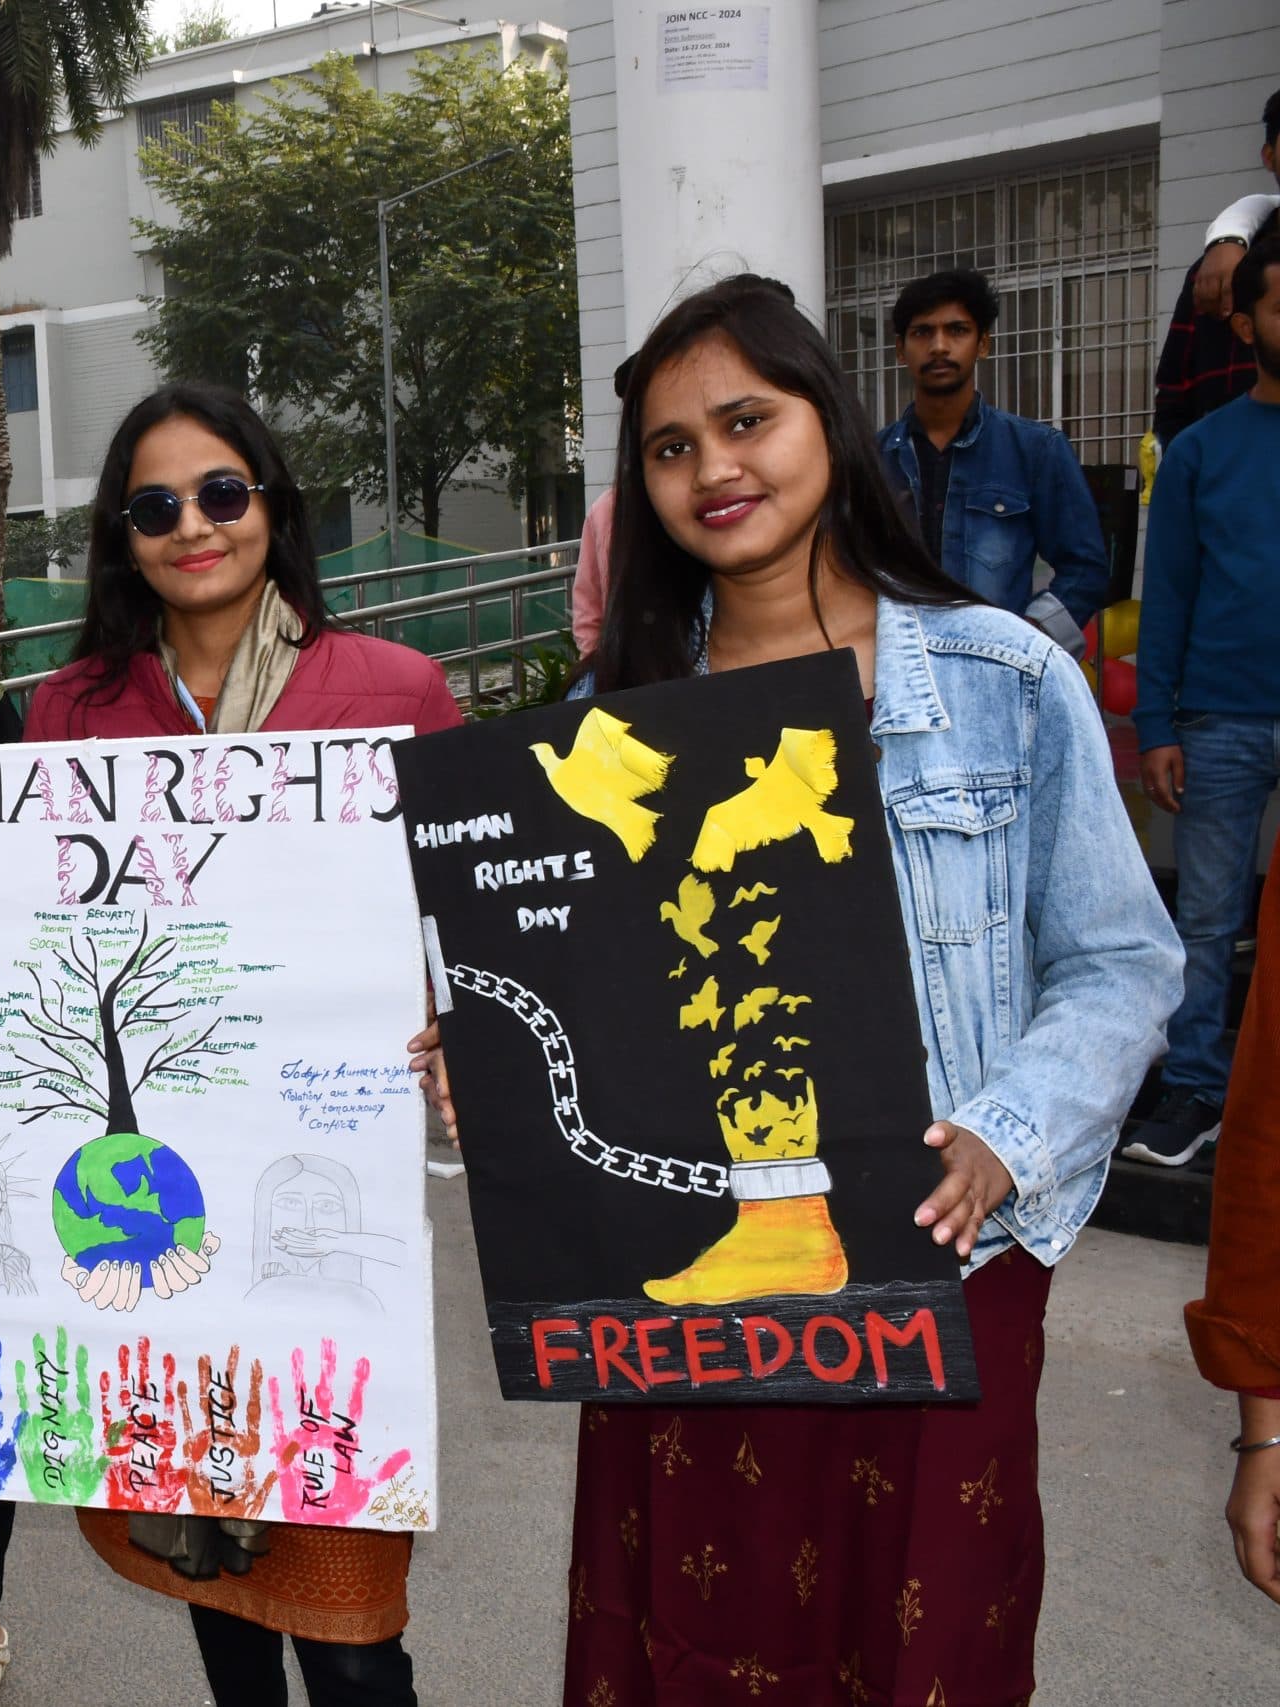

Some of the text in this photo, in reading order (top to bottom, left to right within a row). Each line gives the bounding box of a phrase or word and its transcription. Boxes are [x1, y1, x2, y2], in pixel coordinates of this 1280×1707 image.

[665, 13, 686, 24] JOIN
[688, 11, 708, 21] NCC
[719, 9, 741, 19] 2024
[140, 736, 404, 825] RIGHTS
[413, 811, 515, 849] HUMAN
[55, 832, 228, 907] DAY
[473, 849, 596, 892] RIGHTS
[85, 908, 136, 925] SECURITY
[516, 904, 572, 933] DAY
[166, 920, 233, 931] INTERNATIONAL
[29, 937, 67, 950] SOCIAL
[13, 959, 42, 969] ACTION
[176, 957, 219, 970] HARMONY
[8, 991, 35, 1001] MORAL
[61, 982, 88, 994] EQUAL
[120, 983, 144, 999] HOPE
[177, 996, 224, 1009] RESPECT
[0, 1007, 25, 1018] LEGAL
[66, 1005, 95, 1017] PEOPLE
[132, 1008, 160, 1018] PEACE
[124, 1023, 169, 1039] DIVERSITY
[71, 1042, 96, 1061] LIFE
[202, 1041, 258, 1051] ACCEPTANCE
[175, 1058, 201, 1067] LOVE
[332, 1061, 379, 1080] human
[155, 1071, 202, 1086] HUMANITY
[38, 1078, 79, 1097] FREEDOM
[330, 1089, 350, 1097] are
[51, 1110, 91, 1124] JUSTICE
[528, 1307, 950, 1394] FREEDOM
[35, 1350, 70, 1490] DIGNITY
[127, 1374, 161, 1494] PEACE
[208, 1365, 238, 1505] JUSTICE
[300, 1386, 331, 1511] RULE OF
[331, 1411, 363, 1475] LAW
